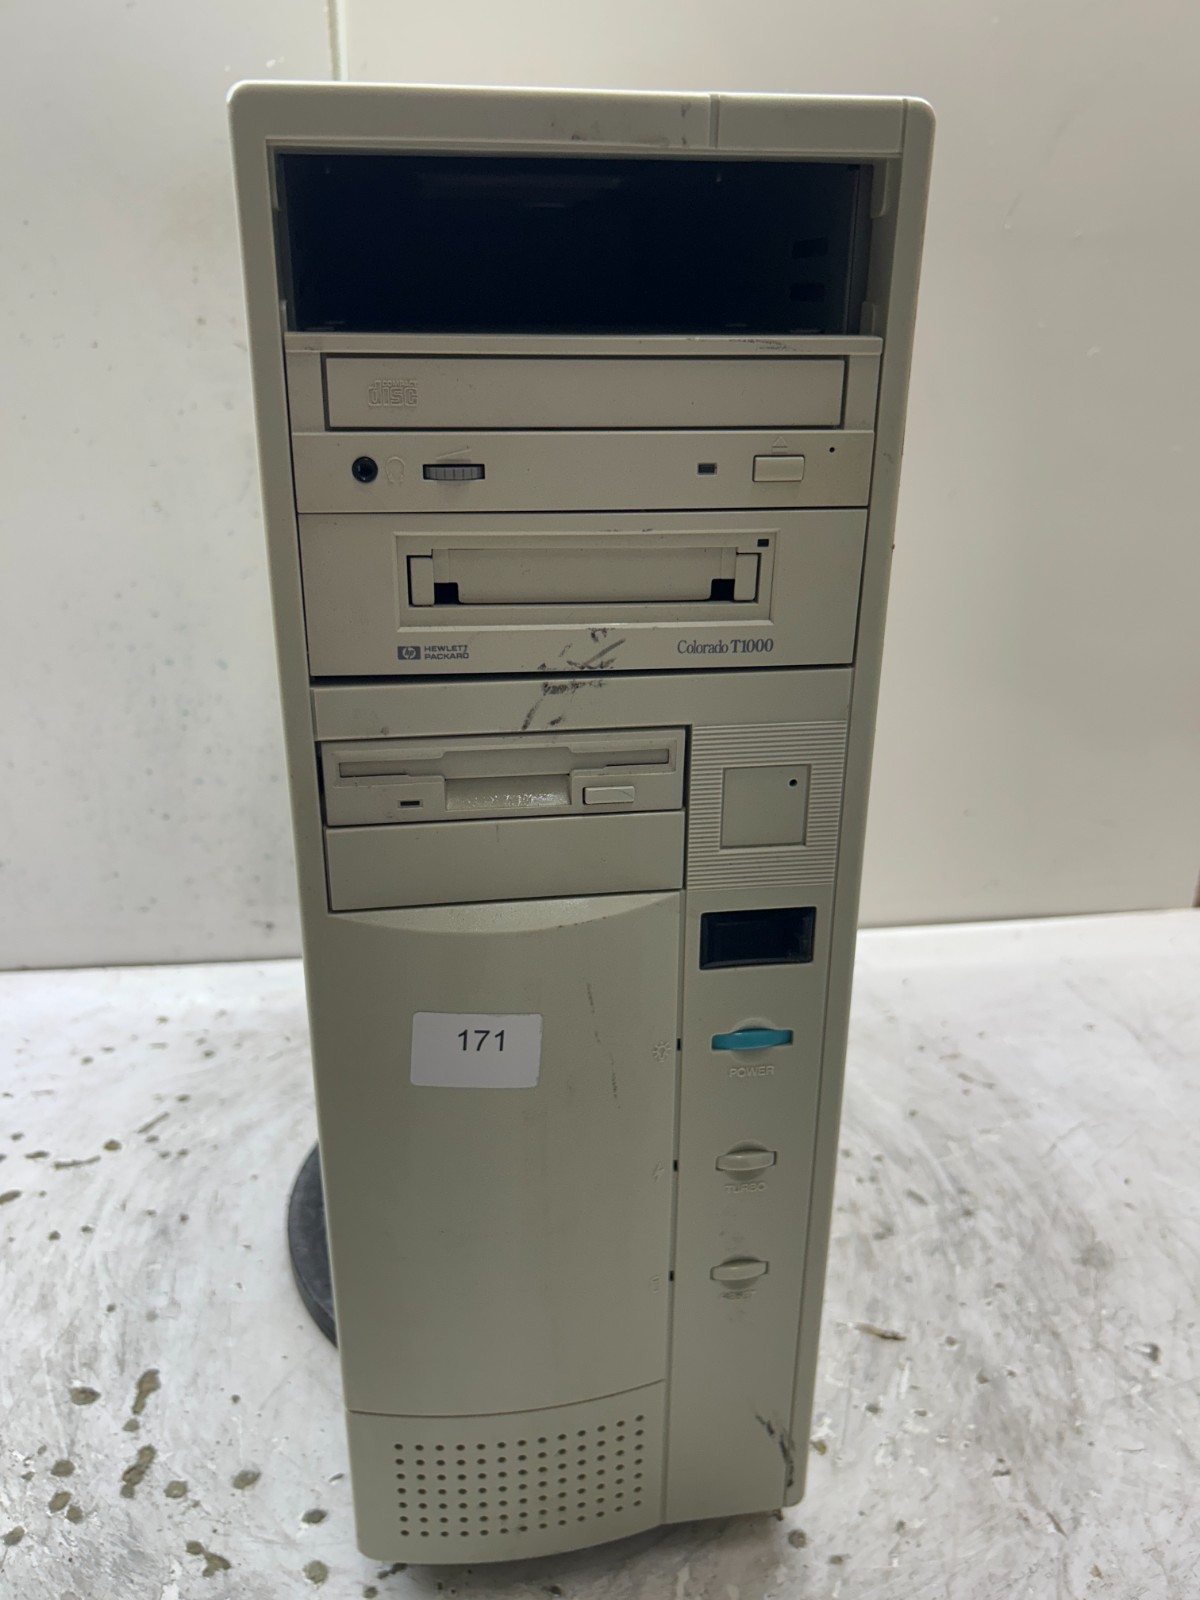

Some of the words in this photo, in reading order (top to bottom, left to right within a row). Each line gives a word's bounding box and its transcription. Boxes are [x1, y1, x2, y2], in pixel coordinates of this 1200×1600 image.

[382, 379, 418, 388] COMPACT
[368, 379, 418, 407] disc
[677, 640, 729, 654] Colorado
[730, 638, 774, 653] T1000
[424, 652, 469, 660] PACKARD
[458, 1029, 504, 1051] 171
[729, 1065, 775, 1078] POWER
[724, 1182, 766, 1193] TURBO
